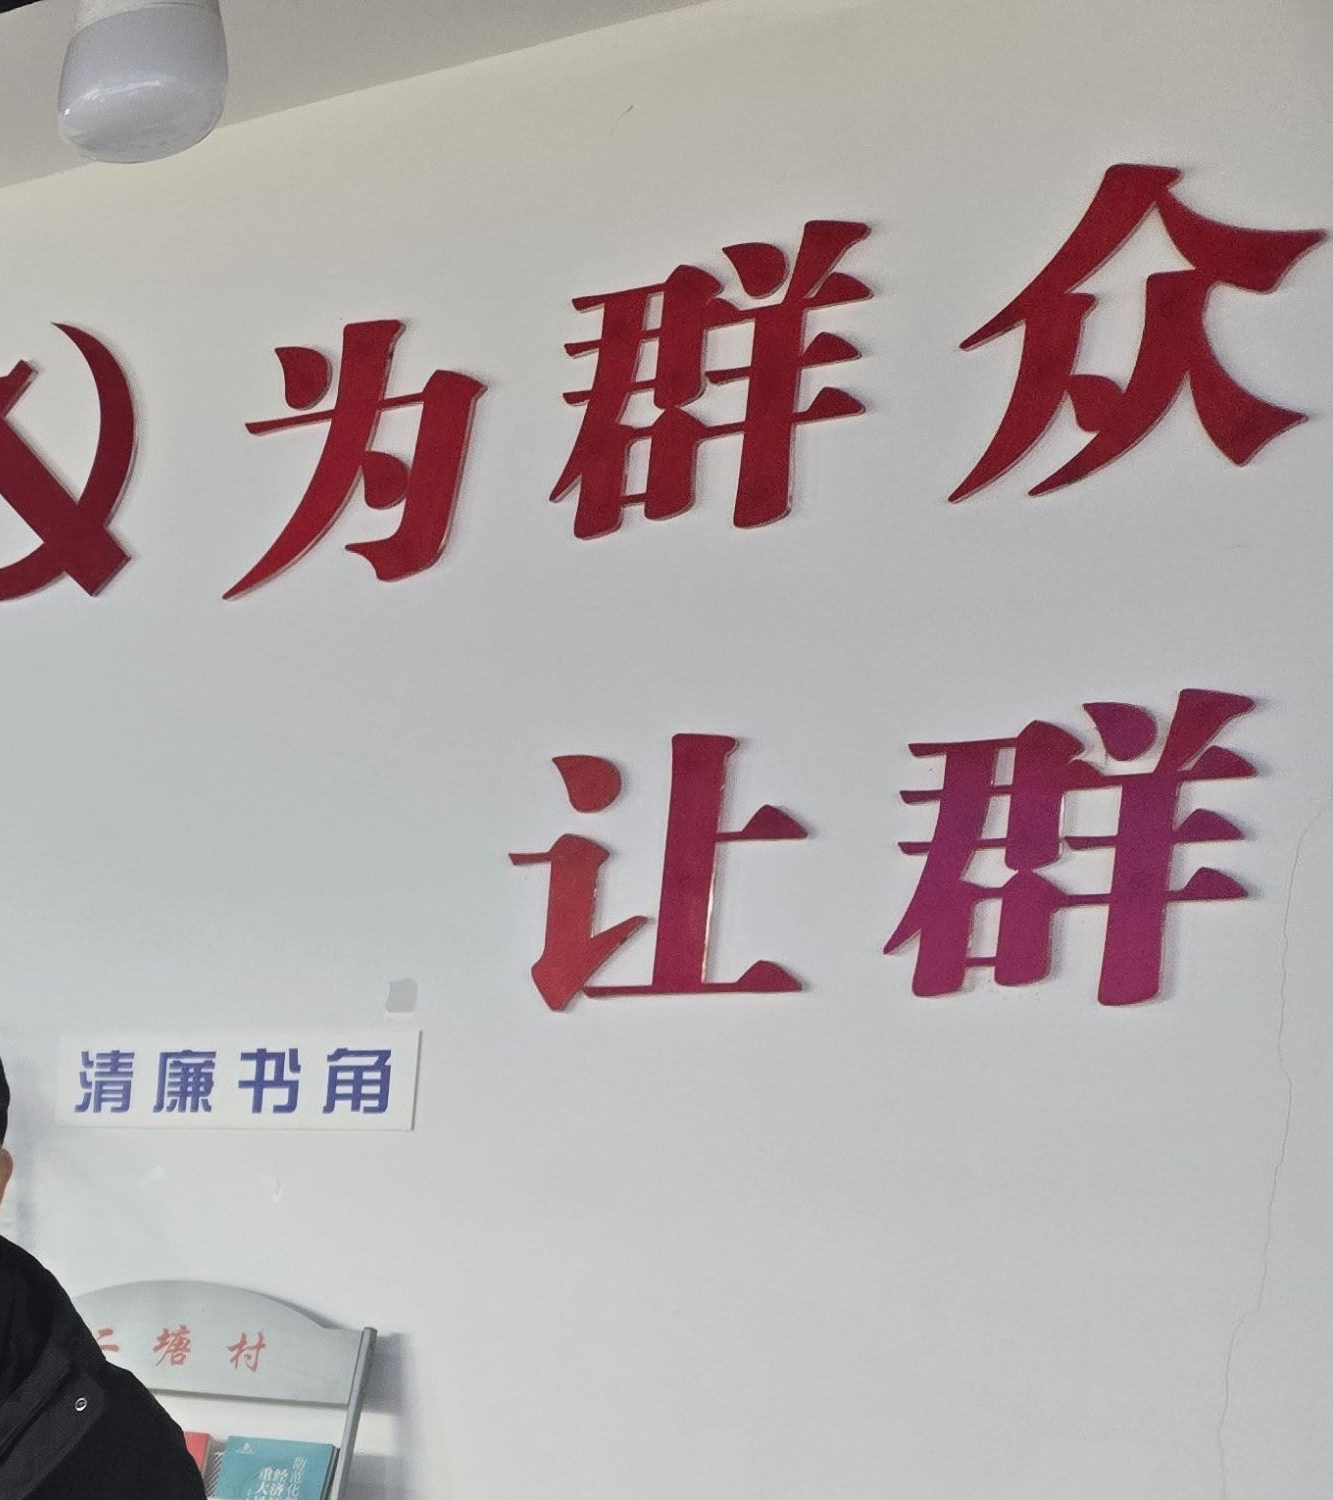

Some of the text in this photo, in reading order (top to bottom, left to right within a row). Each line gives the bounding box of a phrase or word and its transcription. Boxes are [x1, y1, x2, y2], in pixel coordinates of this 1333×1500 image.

[224, 163, 1324, 599] 为群众
[510, 689, 1257, 1012] 让群
[74, 1047, 393, 1114] 清廉书角
